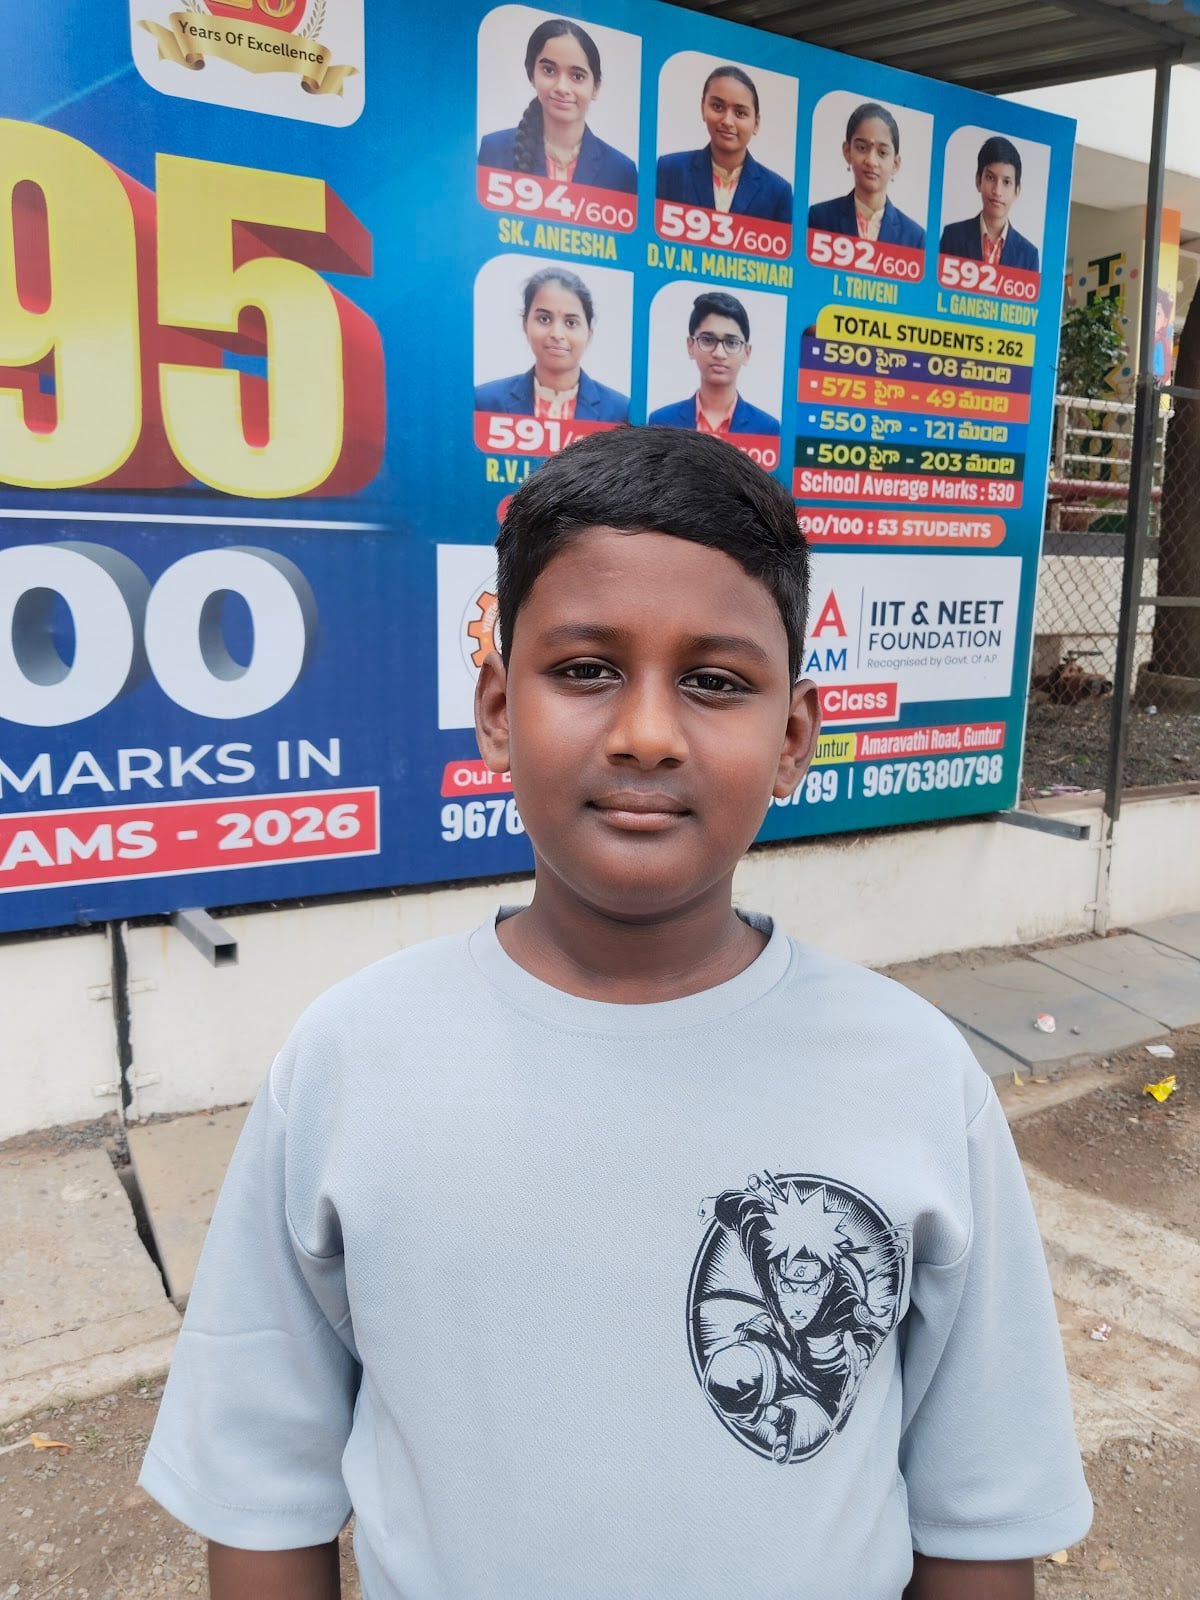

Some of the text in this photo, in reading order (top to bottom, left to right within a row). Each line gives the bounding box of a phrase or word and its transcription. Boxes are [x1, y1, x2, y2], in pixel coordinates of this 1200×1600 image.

[178, 20, 325, 64] Years Of Excellence
[486, 172, 634, 228] 594/600
[498, 217, 618, 261] SK. ANEESHA
[660, 204, 787, 255] 593/600
[647, 242, 794, 288] D.V.N. MAHESWARI
[811, 232, 920, 279] 592/600
[845, 276, 899, 305] TRIVENI
[941, 257, 1036, 299] 592/600
[937, 292, 1039, 328] L. GANESH REDDY
[833, 315, 892, 340] TOTAL
[896, 324, 984, 354] STUDENTS
[996, 339, 1024, 358] 262
[823, 342, 872, 367] 590
[927, 356, 958, 377] 08
[960, 361, 1012, 384] మంది
[821, 376, 867, 400] 575
[926, 389, 957, 409] 49
[958, 390, 1009, 413] మంది
[819, 410, 867, 433] 550
[924, 420, 955, 440] 121
[957, 421, 1009, 443] మంది
[817, 443, 867, 466] 500
[920, 451, 962, 472] 203
[965, 454, 1015, 475] మంది
[800, 470, 859, 494] School
[862, 478, 928, 502] Average
[931, 480, 977, 500] Marks
[988, 483, 1014, 502] 530
[877, 519, 898, 535] 53
[902, 520, 991, 539] STUDENTS
[870, 600, 1004, 627] IIT & NEET
[868, 630, 1001, 651] FOUNDATION
[867, 656, 927, 671] Recognised
[930, 655, 942, 670] by
[944, 654, 968, 666] Govt.
[971, 654, 982, 664] Of
[823, 690, 888, 712] Class
[861, 726, 1002, 756] Amaravathi Road, Guntur
[0, 738, 341, 799] MARKS IN
[453, 768, 495, 787] Our
[862, 754, 1004, 798] 9676380798
[0, 821, 158, 870] AMS
[216, 804, 361, 850] 2026
